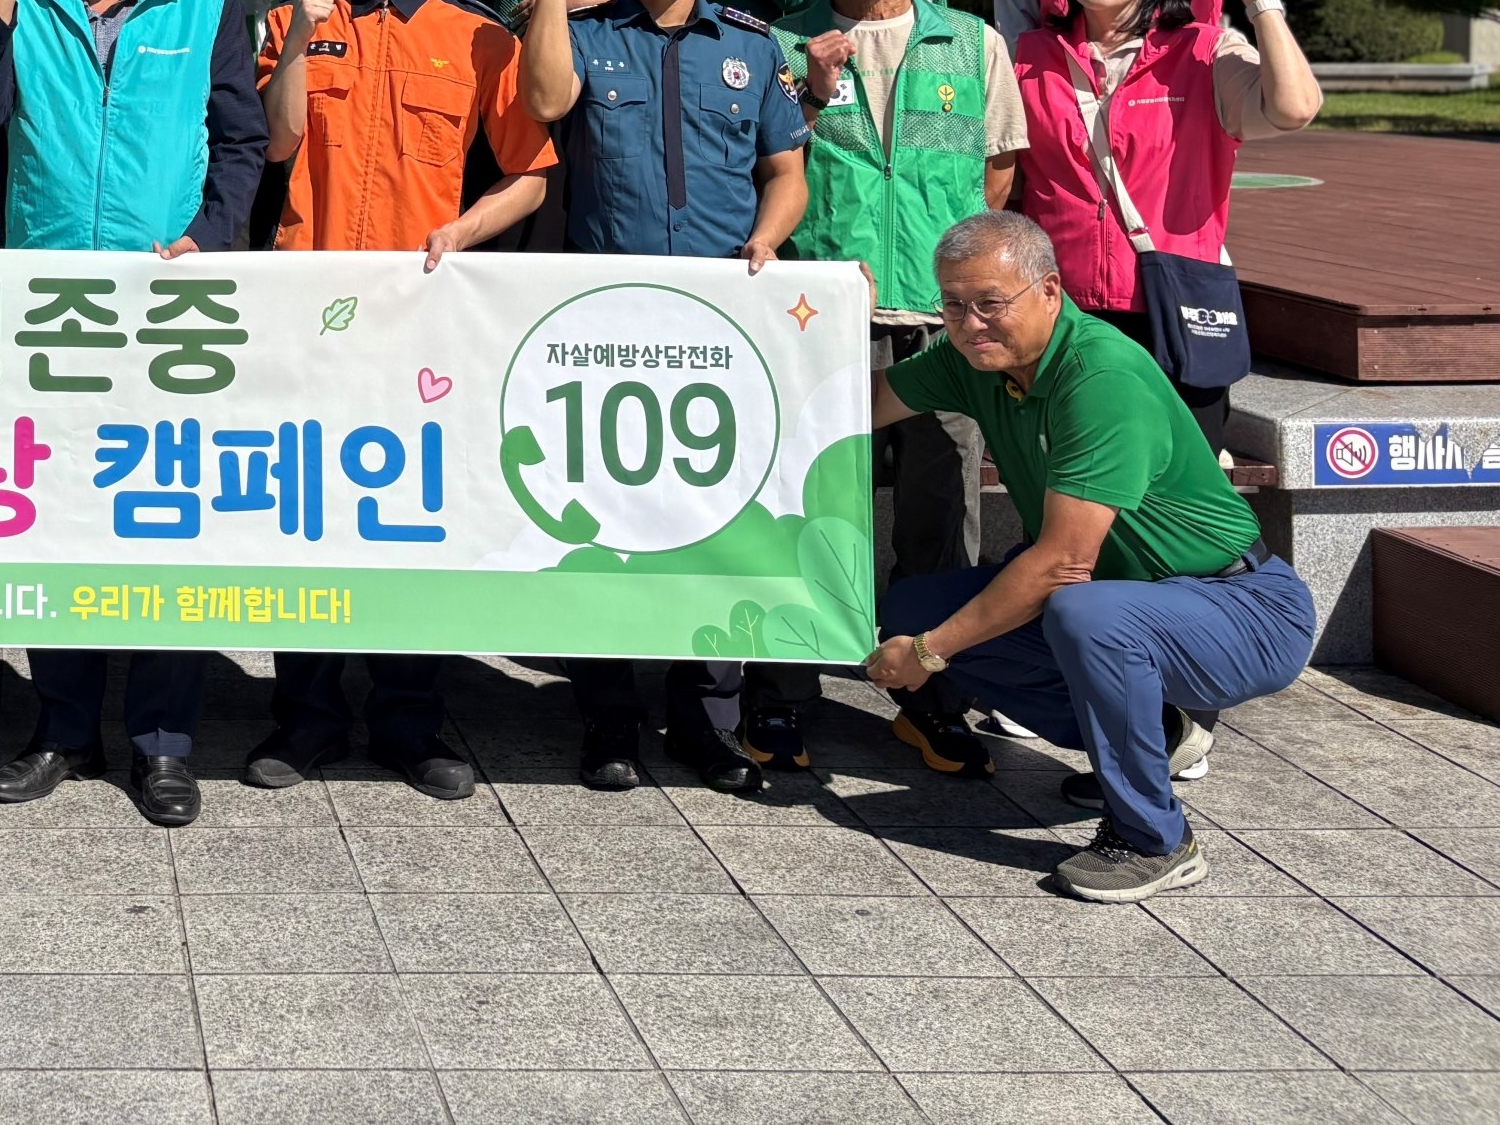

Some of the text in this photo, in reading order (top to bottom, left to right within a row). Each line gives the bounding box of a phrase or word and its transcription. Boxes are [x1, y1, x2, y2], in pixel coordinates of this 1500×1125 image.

[546, 342, 734, 370] 자살예방상담전화
[546, 380, 737, 487] 109
[92, 417, 447, 542] 캠페인
[69, 584, 165, 621] 우리가
[176, 585, 352, 624] 함께합니다!
